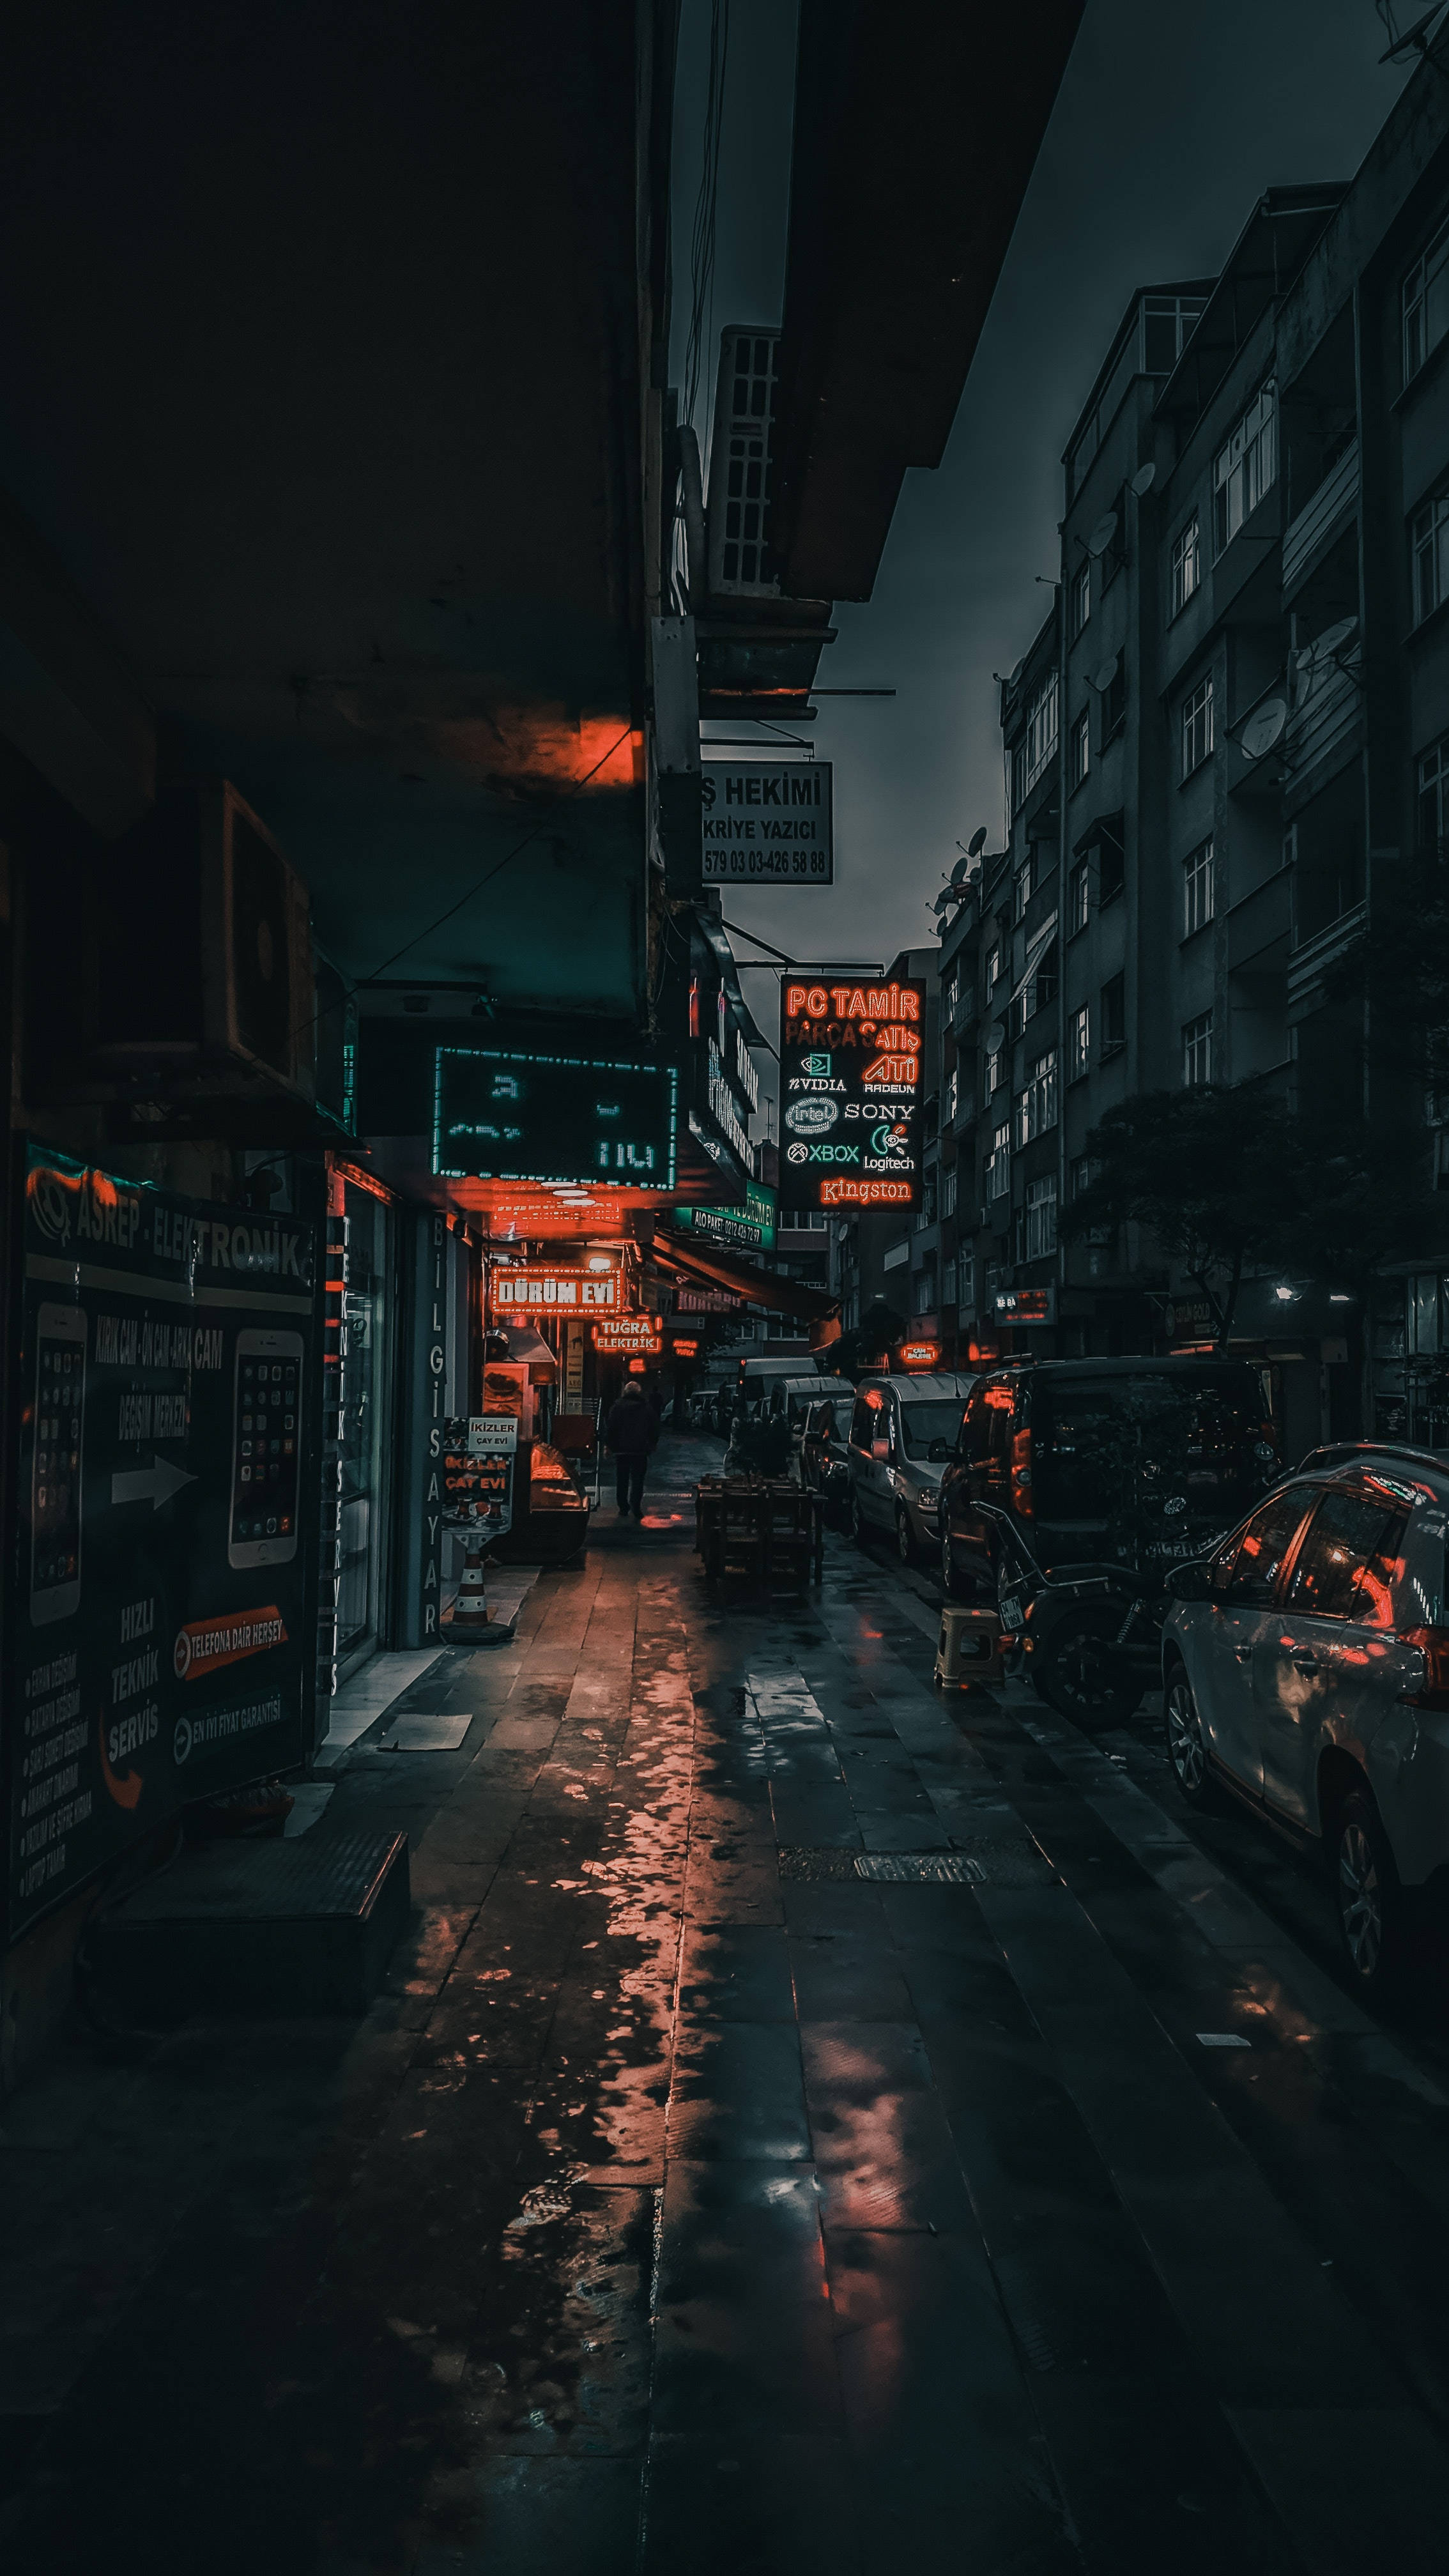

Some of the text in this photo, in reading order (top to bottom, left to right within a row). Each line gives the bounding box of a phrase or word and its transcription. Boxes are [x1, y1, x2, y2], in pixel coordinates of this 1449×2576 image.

[726, 771, 820, 805] HEKİMİ
[760, 820, 816, 839] YAZICI
[705, 850, 726, 872] 579
[731, 850, 744, 872] 03
[792, 850, 806, 873] 58
[811, 850, 825, 873] 88
[788, 983, 918, 1018] PC TAMİR
[785, 1021, 857, 1049] PARÇA
[844, 1103, 915, 1119] SONY
[808, 1144, 860, 1163] XBOX
[864, 1156, 914, 1172] Logitech
[823, 1179, 911, 1202] Kingston
[694, 1211, 707, 1227] ALO
[725, 1220, 737, 1237] 0212
[153, 1206, 301, 1277] ELEKTRONİK
[498, 1278, 614, 1305] DÜRÜM EVİ
[601, 1319, 650, 1334] TUĞRA
[194, 1328, 224, 1370] CAM
[597, 1335, 655, 1349] ELEKTRİK
[424, 1216, 444, 1634] BİLGİSAYAR
[471, 1422, 514, 1433] İKİZLER
[477, 1438, 492, 1446] ÇAY
[446, 1476, 506, 1490] ÇAY EVİ
[120, 1597, 155, 1644] HIZLI
[191, 1618, 283, 1660] TELEFONA DAİR HERŞEY
[112, 1644, 159, 1705] TEKNİK
[108, 1698, 159, 1763] SERVİS
[193, 1693, 281, 1745] EN İYİ FİYAT GARANTİSİ
